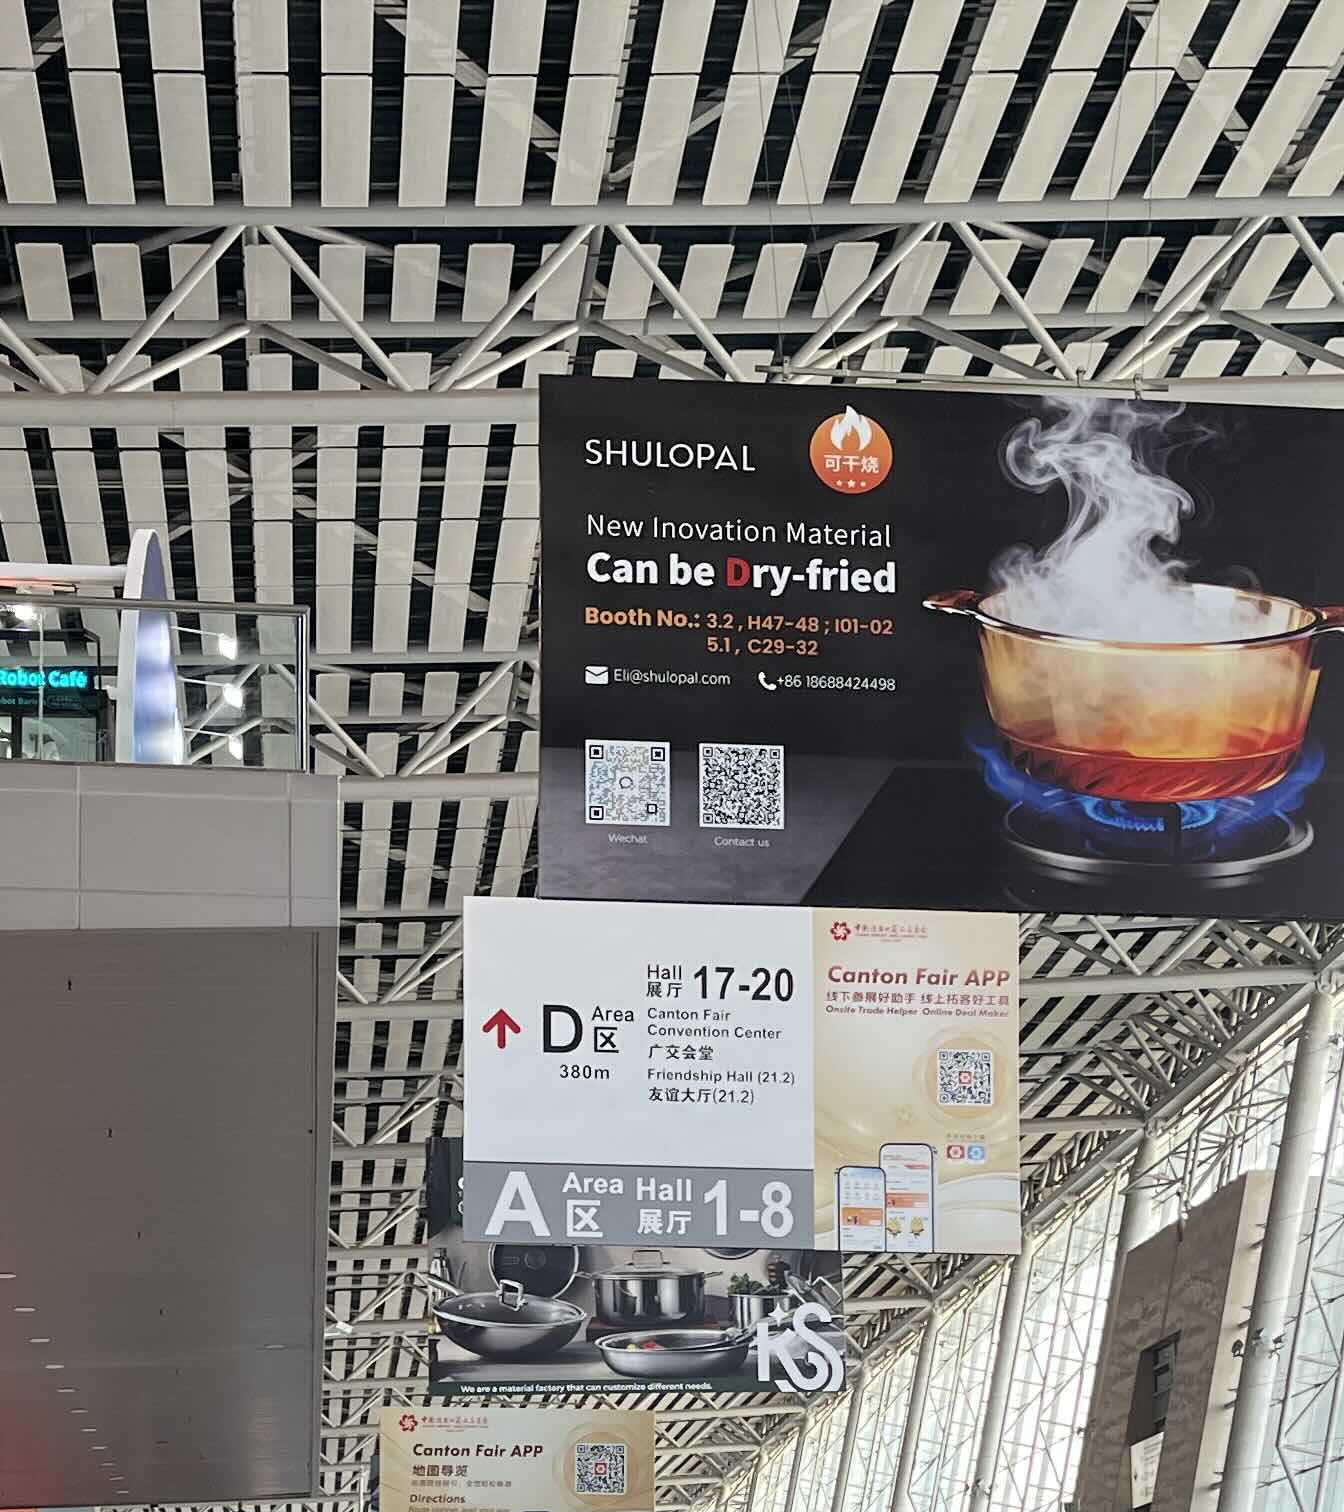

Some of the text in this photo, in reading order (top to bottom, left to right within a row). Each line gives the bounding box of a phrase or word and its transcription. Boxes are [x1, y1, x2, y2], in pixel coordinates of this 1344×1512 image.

[585, 439, 756, 471] SHULOPAL
[824, 454, 880, 473] 可干烧
[587, 514, 891, 547] New Inovation Material
[586, 552, 896, 597] Can be Dry-fried
[585, 607, 652, 628] Booth
[747, 639, 818, 656] C29-32
[613, 669, 731, 686] Eli@shulopal.com
[776, 674, 896, 691] +86 18688424498
[608, 833, 648, 845] Wechat
[714, 836, 770, 847] Contact us
[647, 964, 794, 1001] Hall 17-20
[828, 966, 1010, 987] Canton Fair APP
[646, 982, 683, 998] 展厅
[647, 1007, 731, 1021] Canton Fair
[543, 1004, 634, 1053] D Area
[647, 1024, 782, 1039] Convention Center
[594, 1026, 619, 1053] 区
[648, 1044, 714, 1061] 广交会堂
[559, 1064, 610, 1079] 380m
[647, 1068, 795, 1086] Friendship Hall (21.2)
[484, 1170, 794, 1239] A Area Hall 1-8
[567, 1200, 692, 1238] 区 展厅
[460, 1385, 475, 1393] We
[499, 1384, 534, 1392] material
[535, 1384, 565, 1394] factory
[603, 1383, 645, 1391] customize
[647, 1383, 683, 1391] different
[413, 1443, 544, 1458] Canton Fair APP
[409, 1494, 466, 1504] Directions
